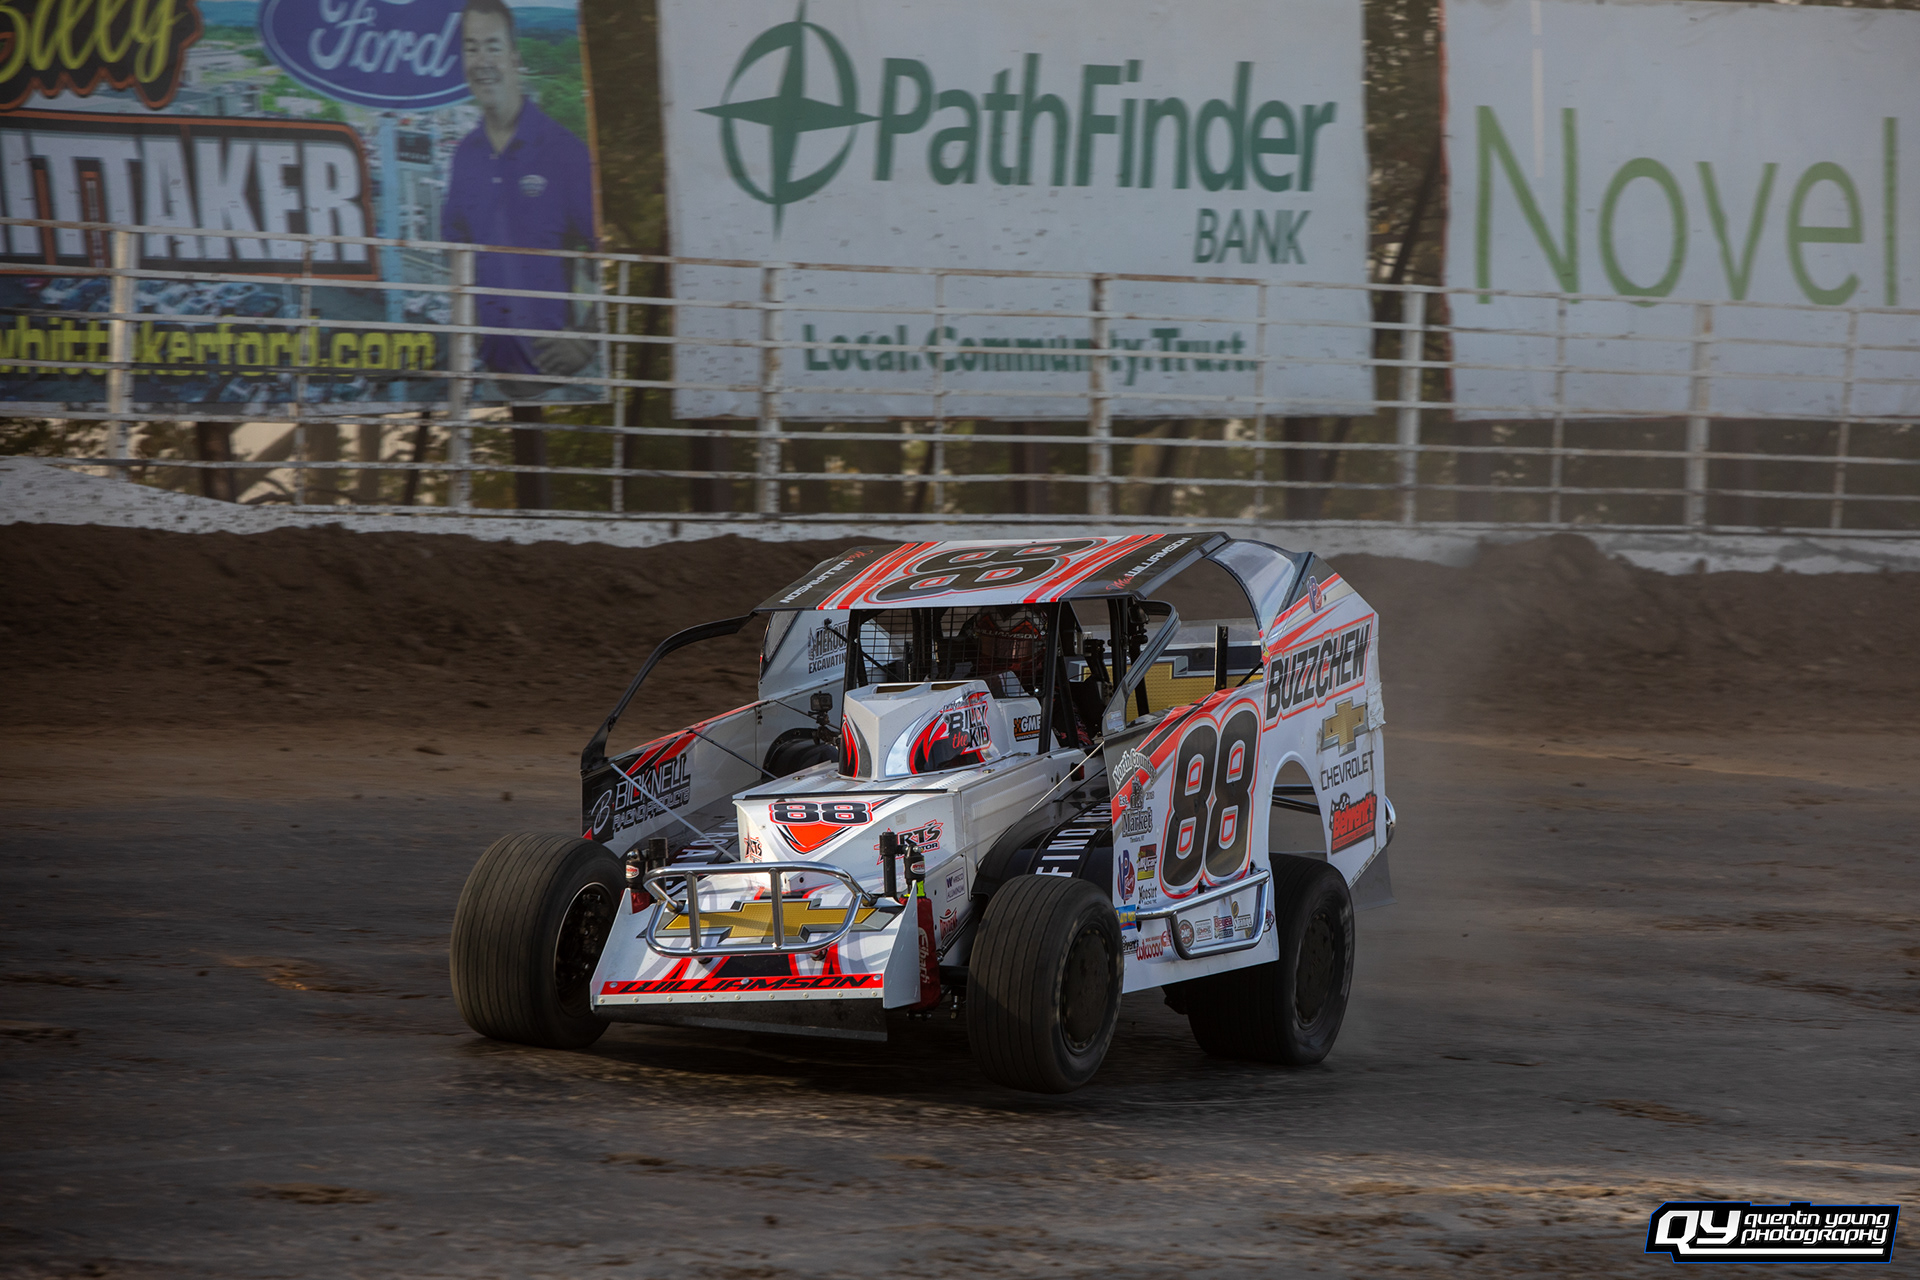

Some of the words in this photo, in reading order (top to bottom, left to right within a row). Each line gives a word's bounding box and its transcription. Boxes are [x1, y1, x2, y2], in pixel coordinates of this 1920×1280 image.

[0, 0, 189, 83] illy
[308, 0, 463, 77] Ford
[873, 52, 1337, 192] PathFinder
[0, 130, 370, 264] ITTAKER
[1475, 105, 1898, 307] Novel
[1194, 207, 1311, 265] BANK
[0, 315, 436, 377] hittkerford.com
[868, 539, 1107, 604] 88
[1124, 537, 1193, 577] WILLIAMSON
[976, 628, 1039, 640] ILLIAMSON
[808, 653, 847, 674] EXCAVATIN
[1265, 622, 1371, 721] BUZZCHEW
[948, 703, 986, 732] BILLY
[952, 731, 969, 749] the
[968, 725, 989, 749] KID
[614, 756, 691, 811] BICKNELL
[1321, 750, 1375, 791] CHEVROLET
[613, 803, 648, 831] RACING
[769, 802, 873, 827] 88
[1122, 807, 1152, 833] Market
[1161, 707, 1260, 893] 88
[1035, 828, 1098, 878] FIND
[618, 974, 873, 994] WILLIAMSON
